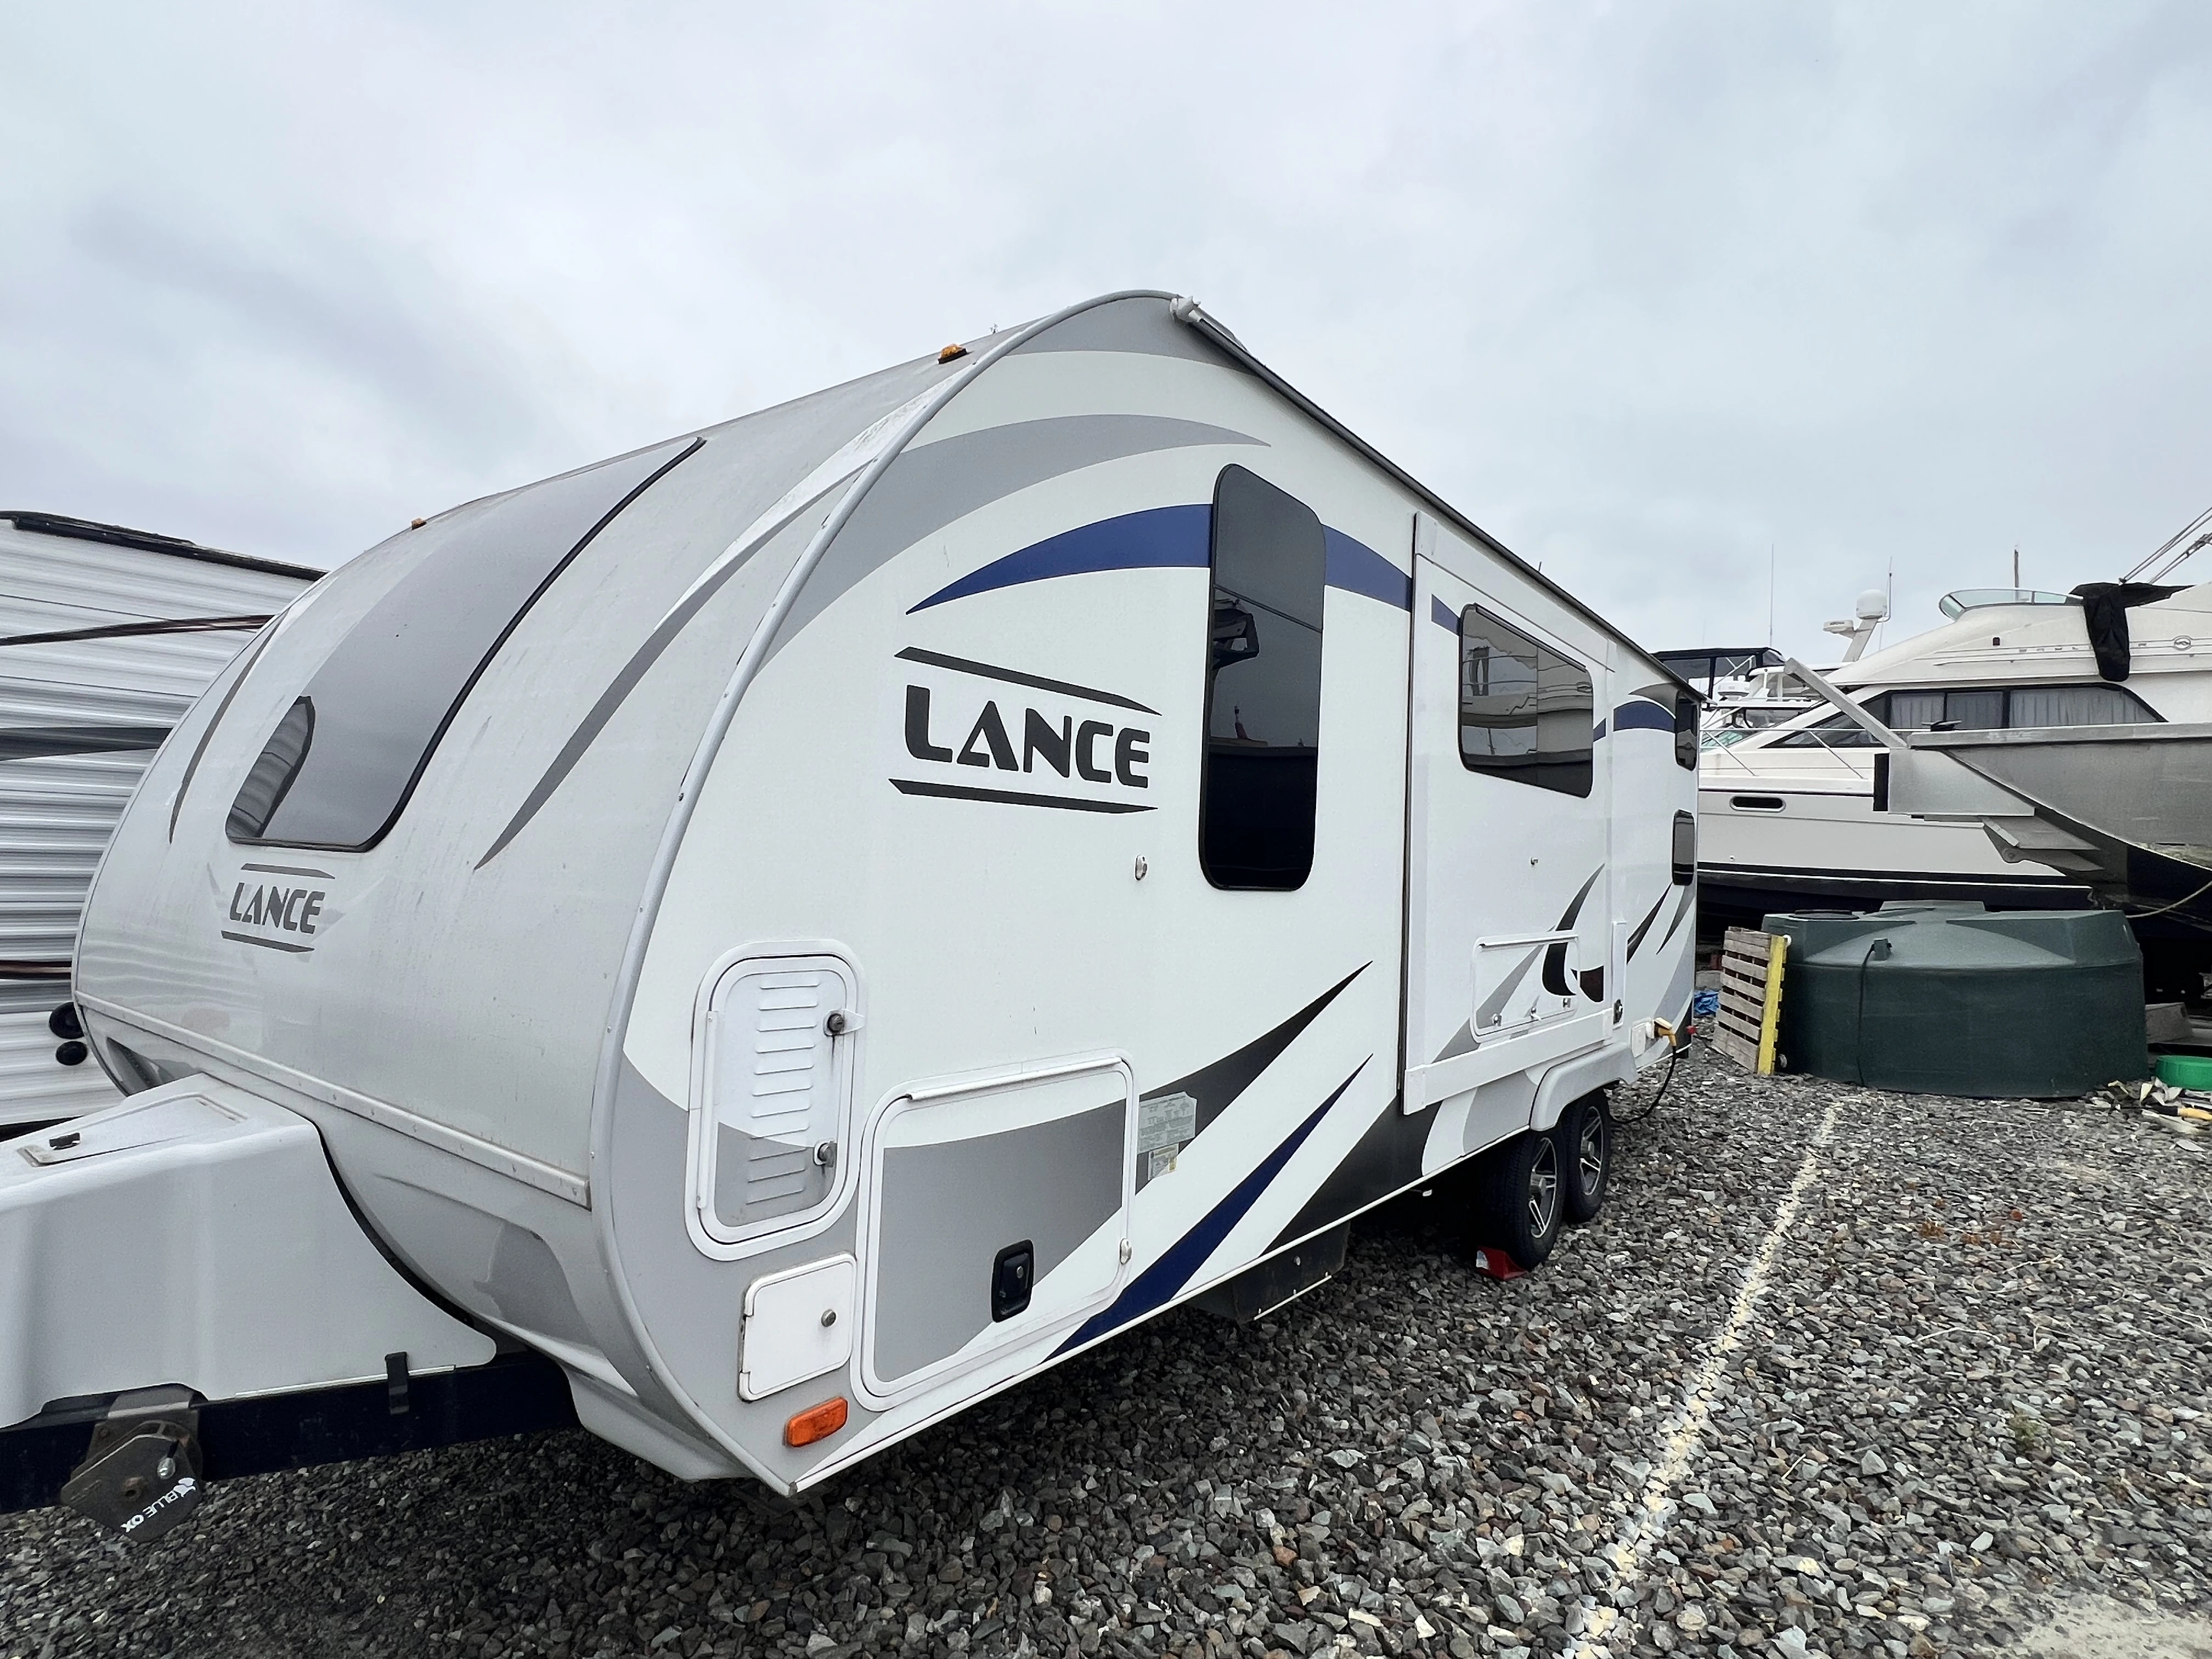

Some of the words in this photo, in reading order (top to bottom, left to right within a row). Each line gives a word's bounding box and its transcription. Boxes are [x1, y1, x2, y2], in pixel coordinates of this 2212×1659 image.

[905, 684, 1150, 789] LANCE
[229, 882, 325, 935] LANCE
[120, 1514, 144, 1533] OX
[142, 1490, 179, 1519] BLUE
